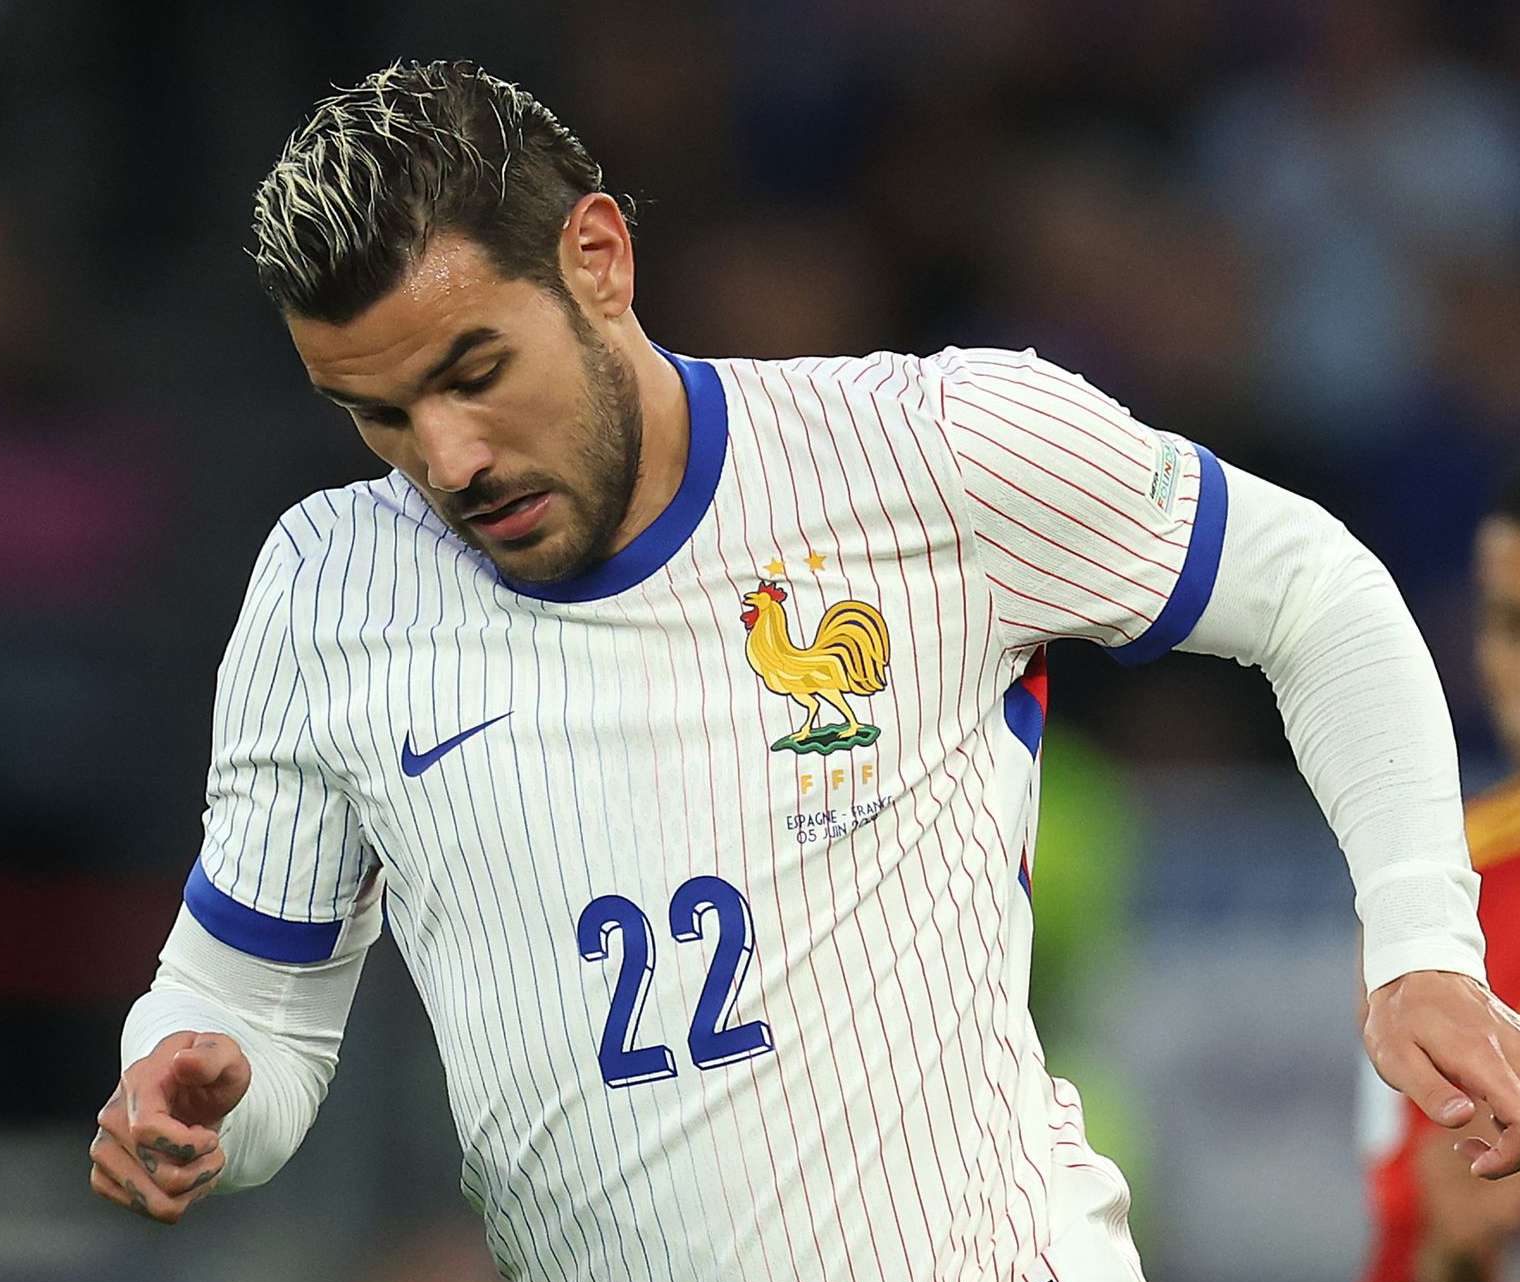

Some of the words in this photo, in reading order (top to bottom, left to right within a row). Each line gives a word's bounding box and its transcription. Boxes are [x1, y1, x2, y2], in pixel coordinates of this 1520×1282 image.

[786, 809, 838, 831] ESPAGNE
[796, 829, 818, 845] 05
[822, 823, 848, 840] JUIN
[577, 875, 775, 1089] 22
